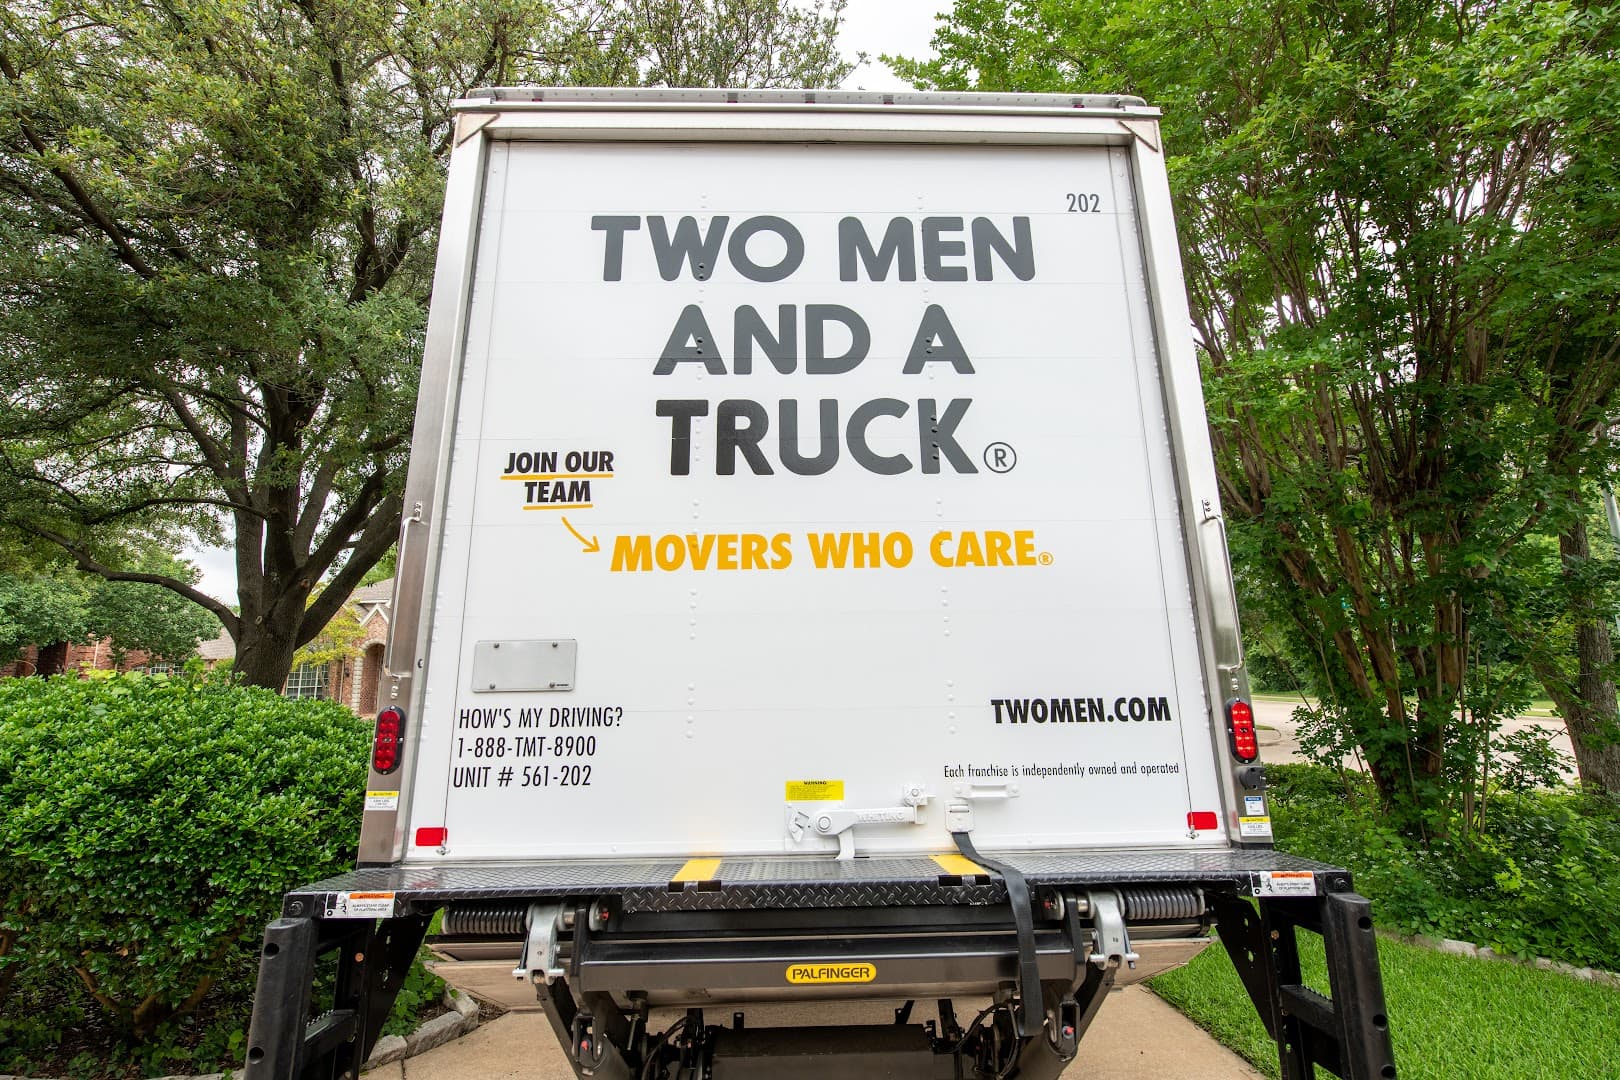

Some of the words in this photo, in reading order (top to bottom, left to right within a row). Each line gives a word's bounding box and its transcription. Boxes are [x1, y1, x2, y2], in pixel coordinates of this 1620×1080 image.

[1066, 193, 1101, 213] 202
[591, 215, 805, 283] TWO
[839, 216, 1036, 282] MEN
[652, 303, 871, 376] AND
[902, 303, 976, 375] A
[503, 451, 558, 474] JOIN
[565, 450, 614, 473] OUR
[524, 480, 591, 503] TEAM
[610, 532, 793, 573] MOVERS
[807, 531, 914, 570] WHO
[459, 708, 512, 729] HOW'S
[518, 707, 543, 729] MY
[549, 706, 623, 728] DRIVING?
[990, 696, 1172, 724] TWOMEN.COM
[458, 735, 597, 759] 1-888-TMT-8900
[453, 766, 492, 788] UNIT
[497, 766, 514, 787] #
[521, 764, 592, 787] 561-202
[944, 763, 965, 778] Each
[968, 763, 1009, 777] franchise
[1011, 765, 1019, 777] is
[1022, 762, 1085, 779] independently
[1088, 761, 1117, 775] owned
[1120, 761, 1137, 775] and
[1140, 762, 1179, 777] operated
[792, 967, 871, 980] PALFINGER
